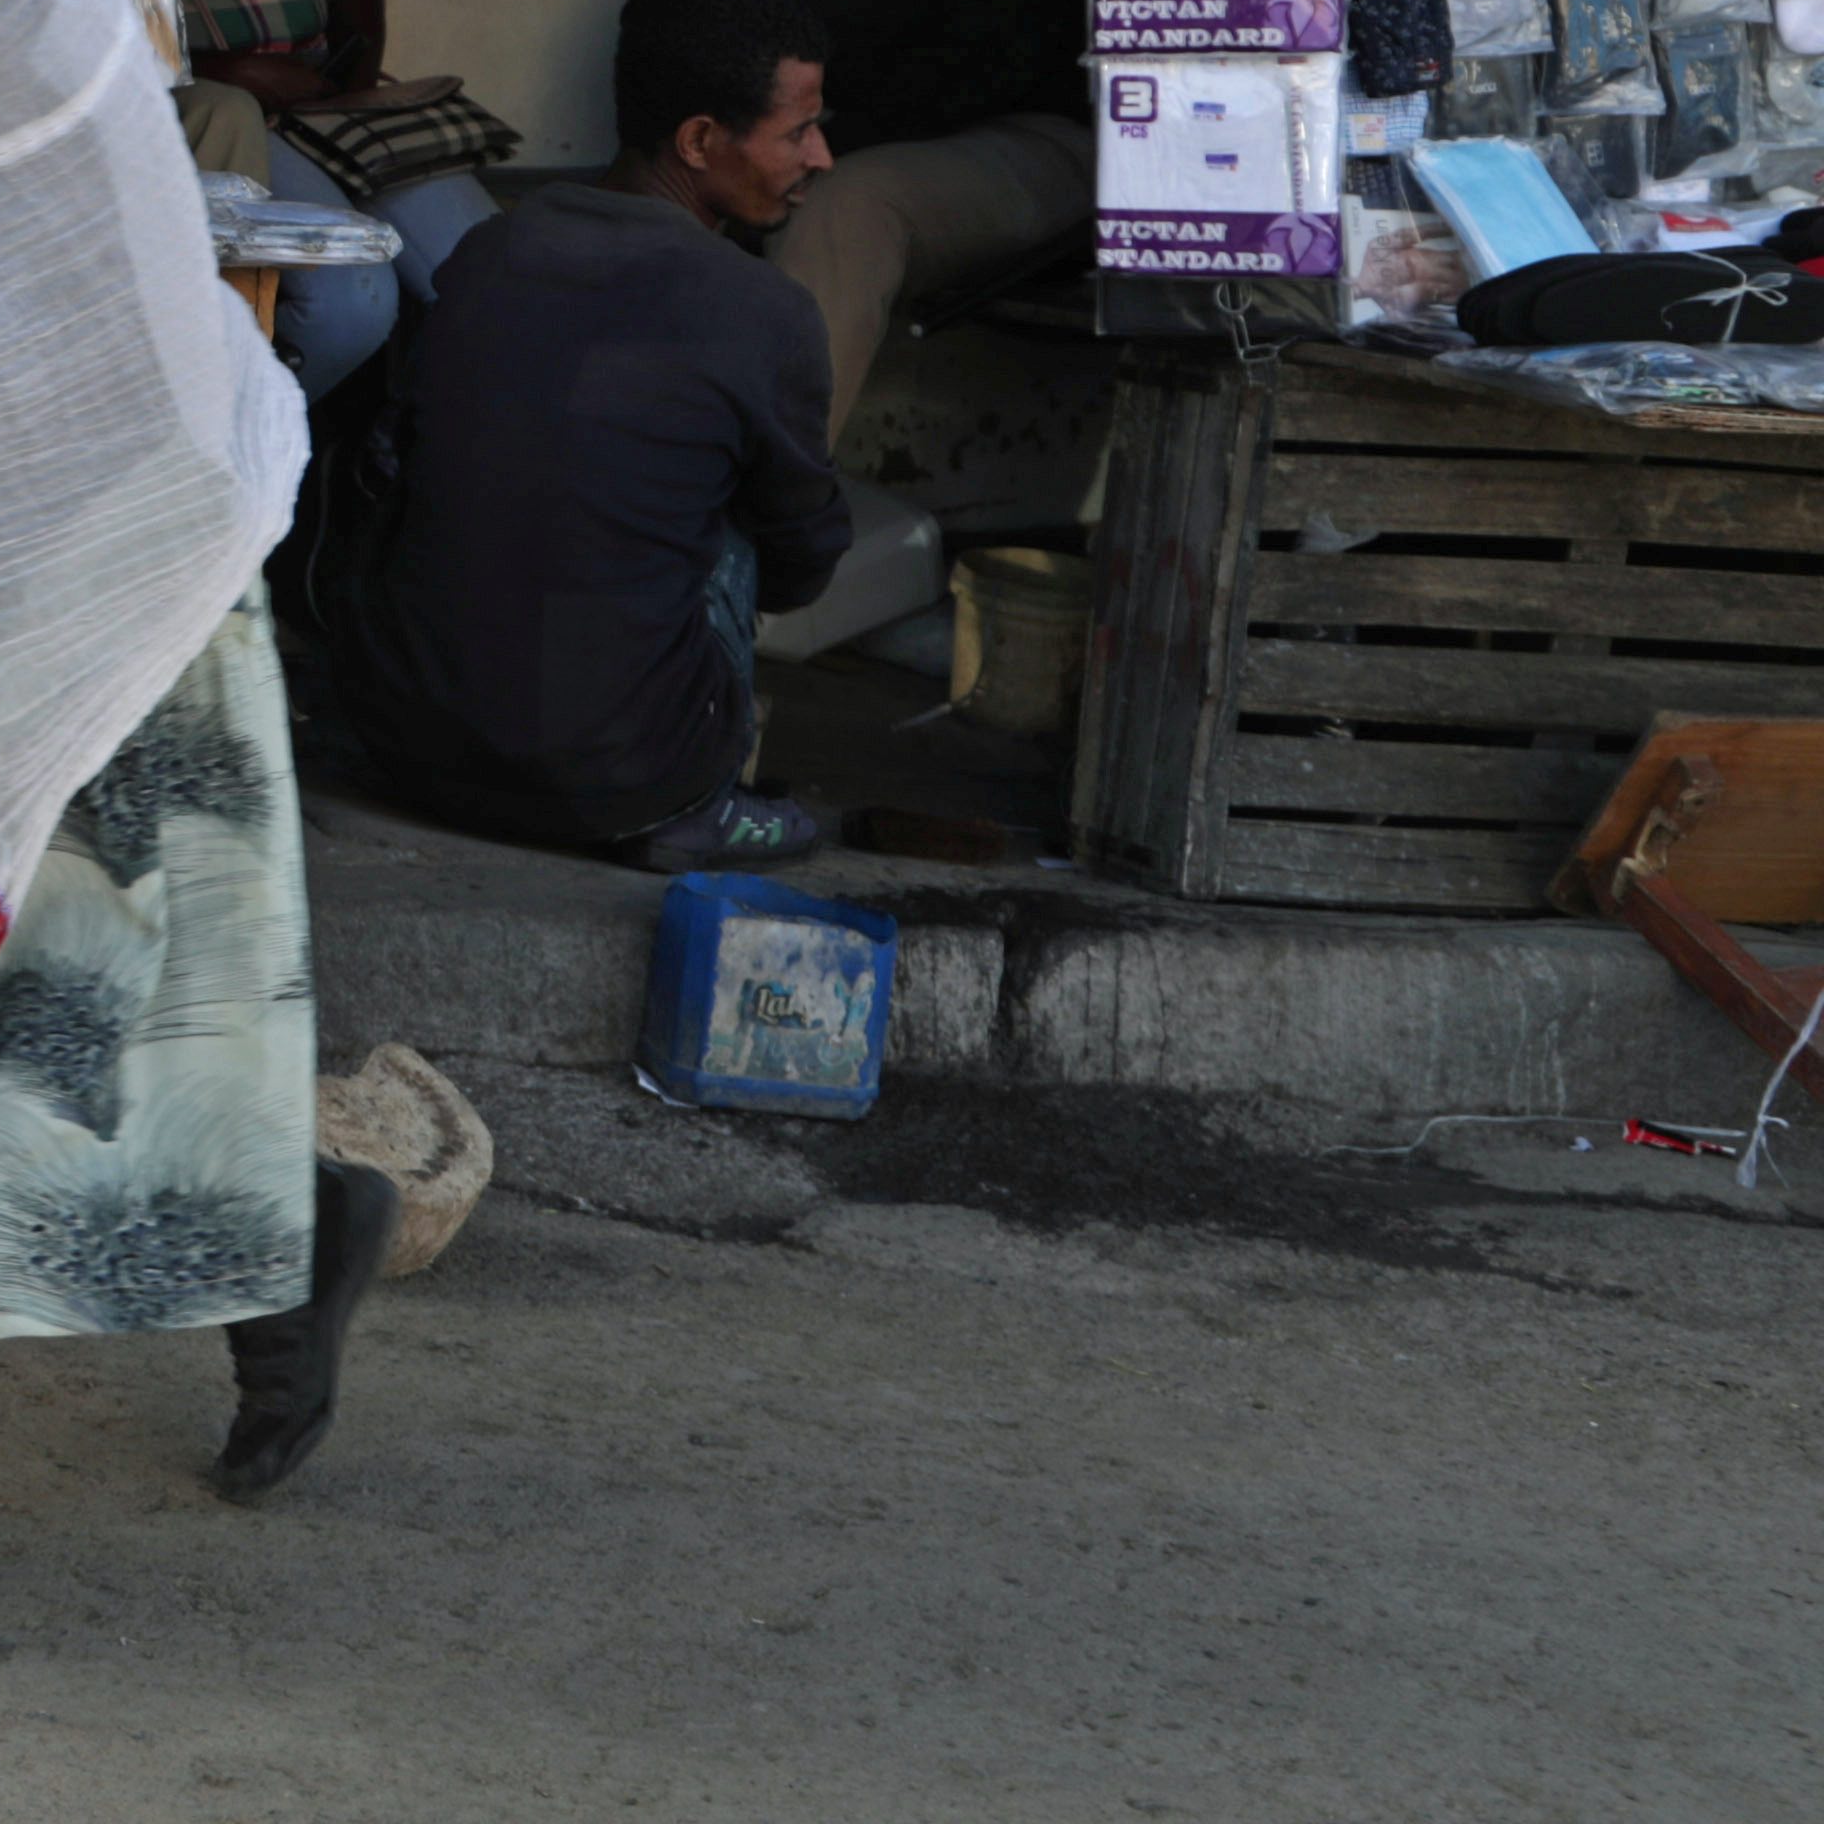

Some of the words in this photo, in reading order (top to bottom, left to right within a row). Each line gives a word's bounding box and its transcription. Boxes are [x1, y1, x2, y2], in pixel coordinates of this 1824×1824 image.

[1096, 0, 1228, 27] VICTAN
[1095, 27, 1285, 49] STANDARD
[1118, 81, 1153, 118] 3
[1119, 124, 1148, 139] PCS
[1096, 221, 1228, 247] VICTAN
[1096, 249, 1285, 270] STANDARD
